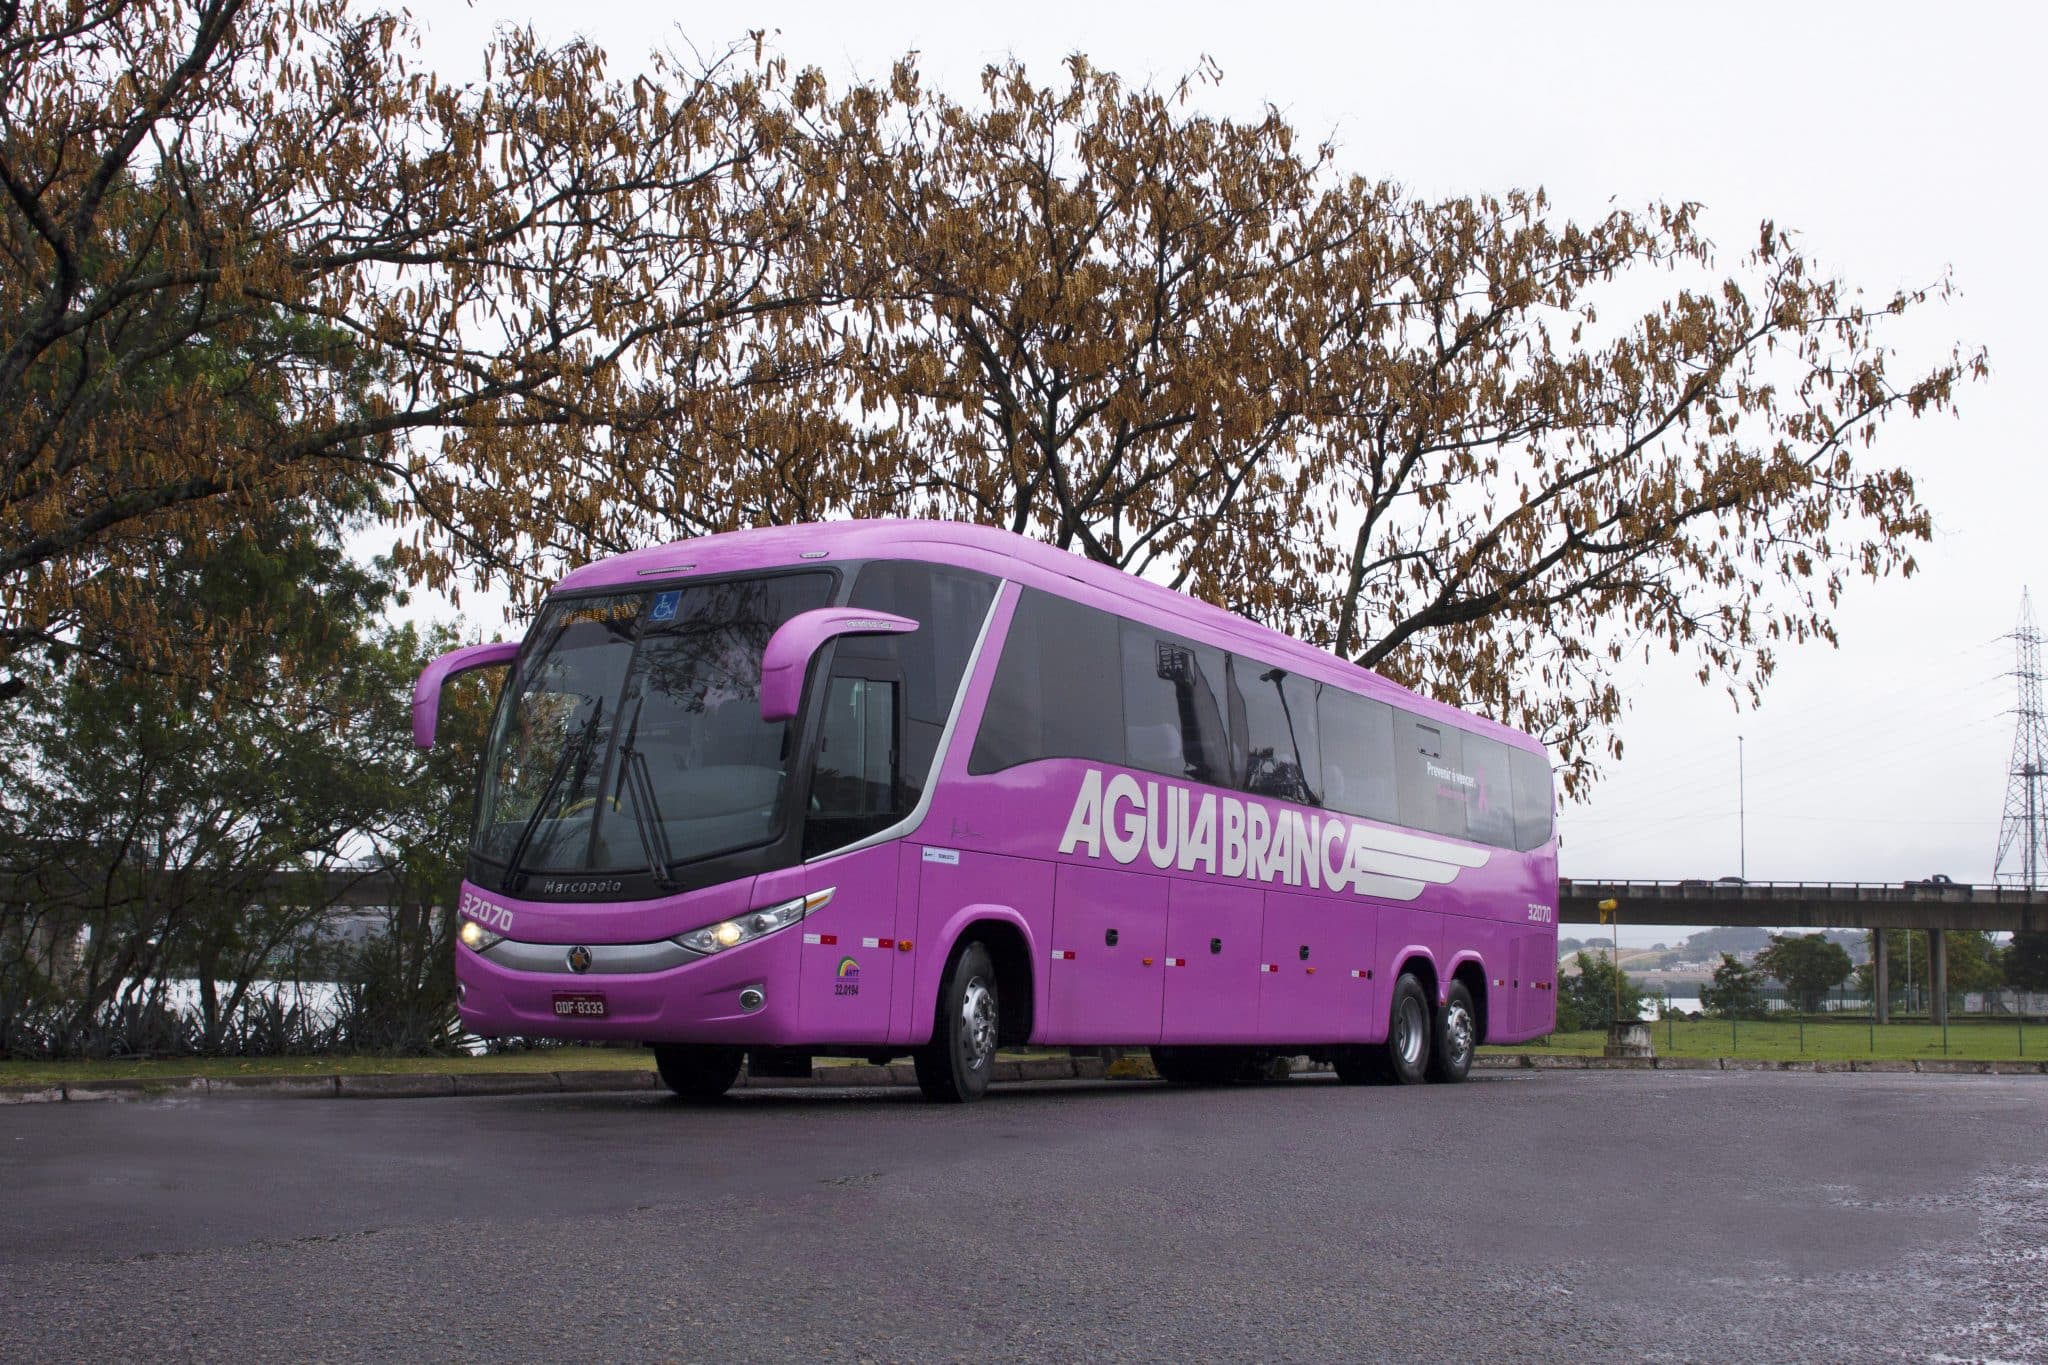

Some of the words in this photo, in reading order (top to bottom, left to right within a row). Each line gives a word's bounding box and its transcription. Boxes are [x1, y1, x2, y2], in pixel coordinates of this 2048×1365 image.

[1426, 761, 1451, 781] Prevenir
[543, 880, 622, 896] Marcopolo
[462, 892, 514, 932] 32070
[1527, 903, 1552, 923] 32070
